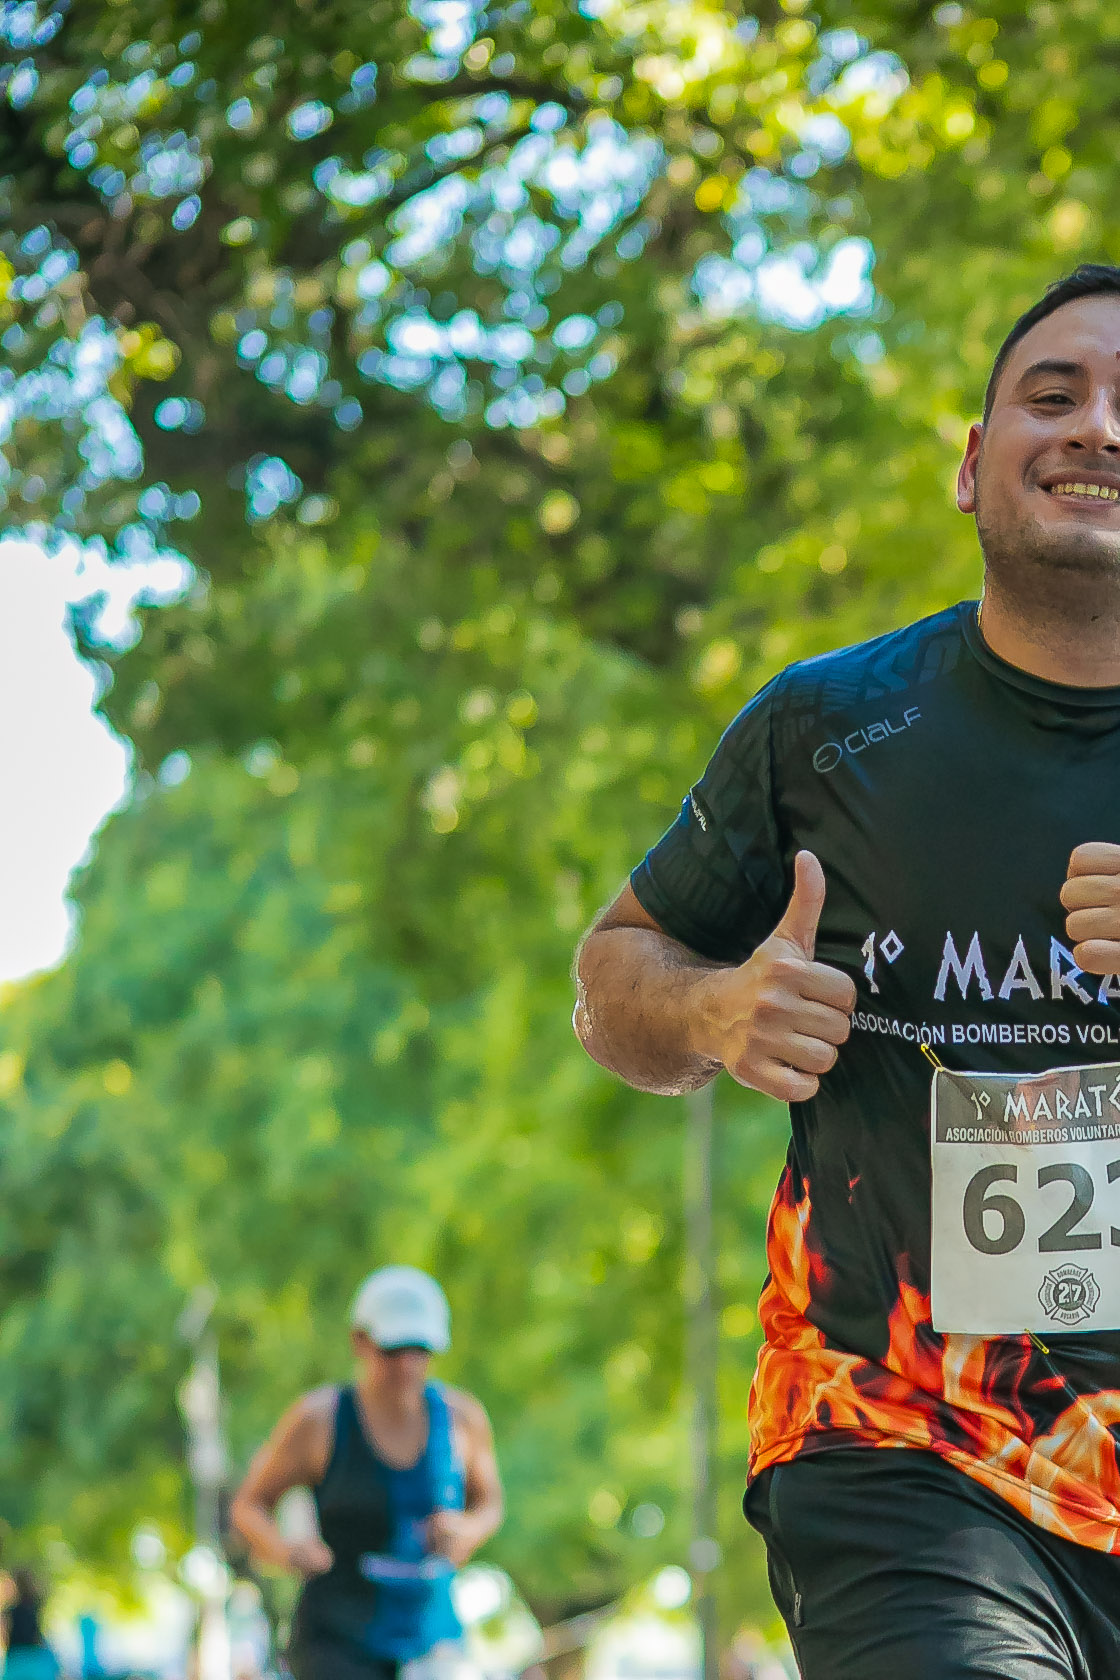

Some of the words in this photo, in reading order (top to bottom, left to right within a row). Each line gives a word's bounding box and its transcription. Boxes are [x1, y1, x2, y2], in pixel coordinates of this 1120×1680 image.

[952, 1023, 1071, 1044] BOMBEROS
[1008, 1126, 1069, 1144] BOMBEROS
[1058, 1281, 1082, 1304] 27
